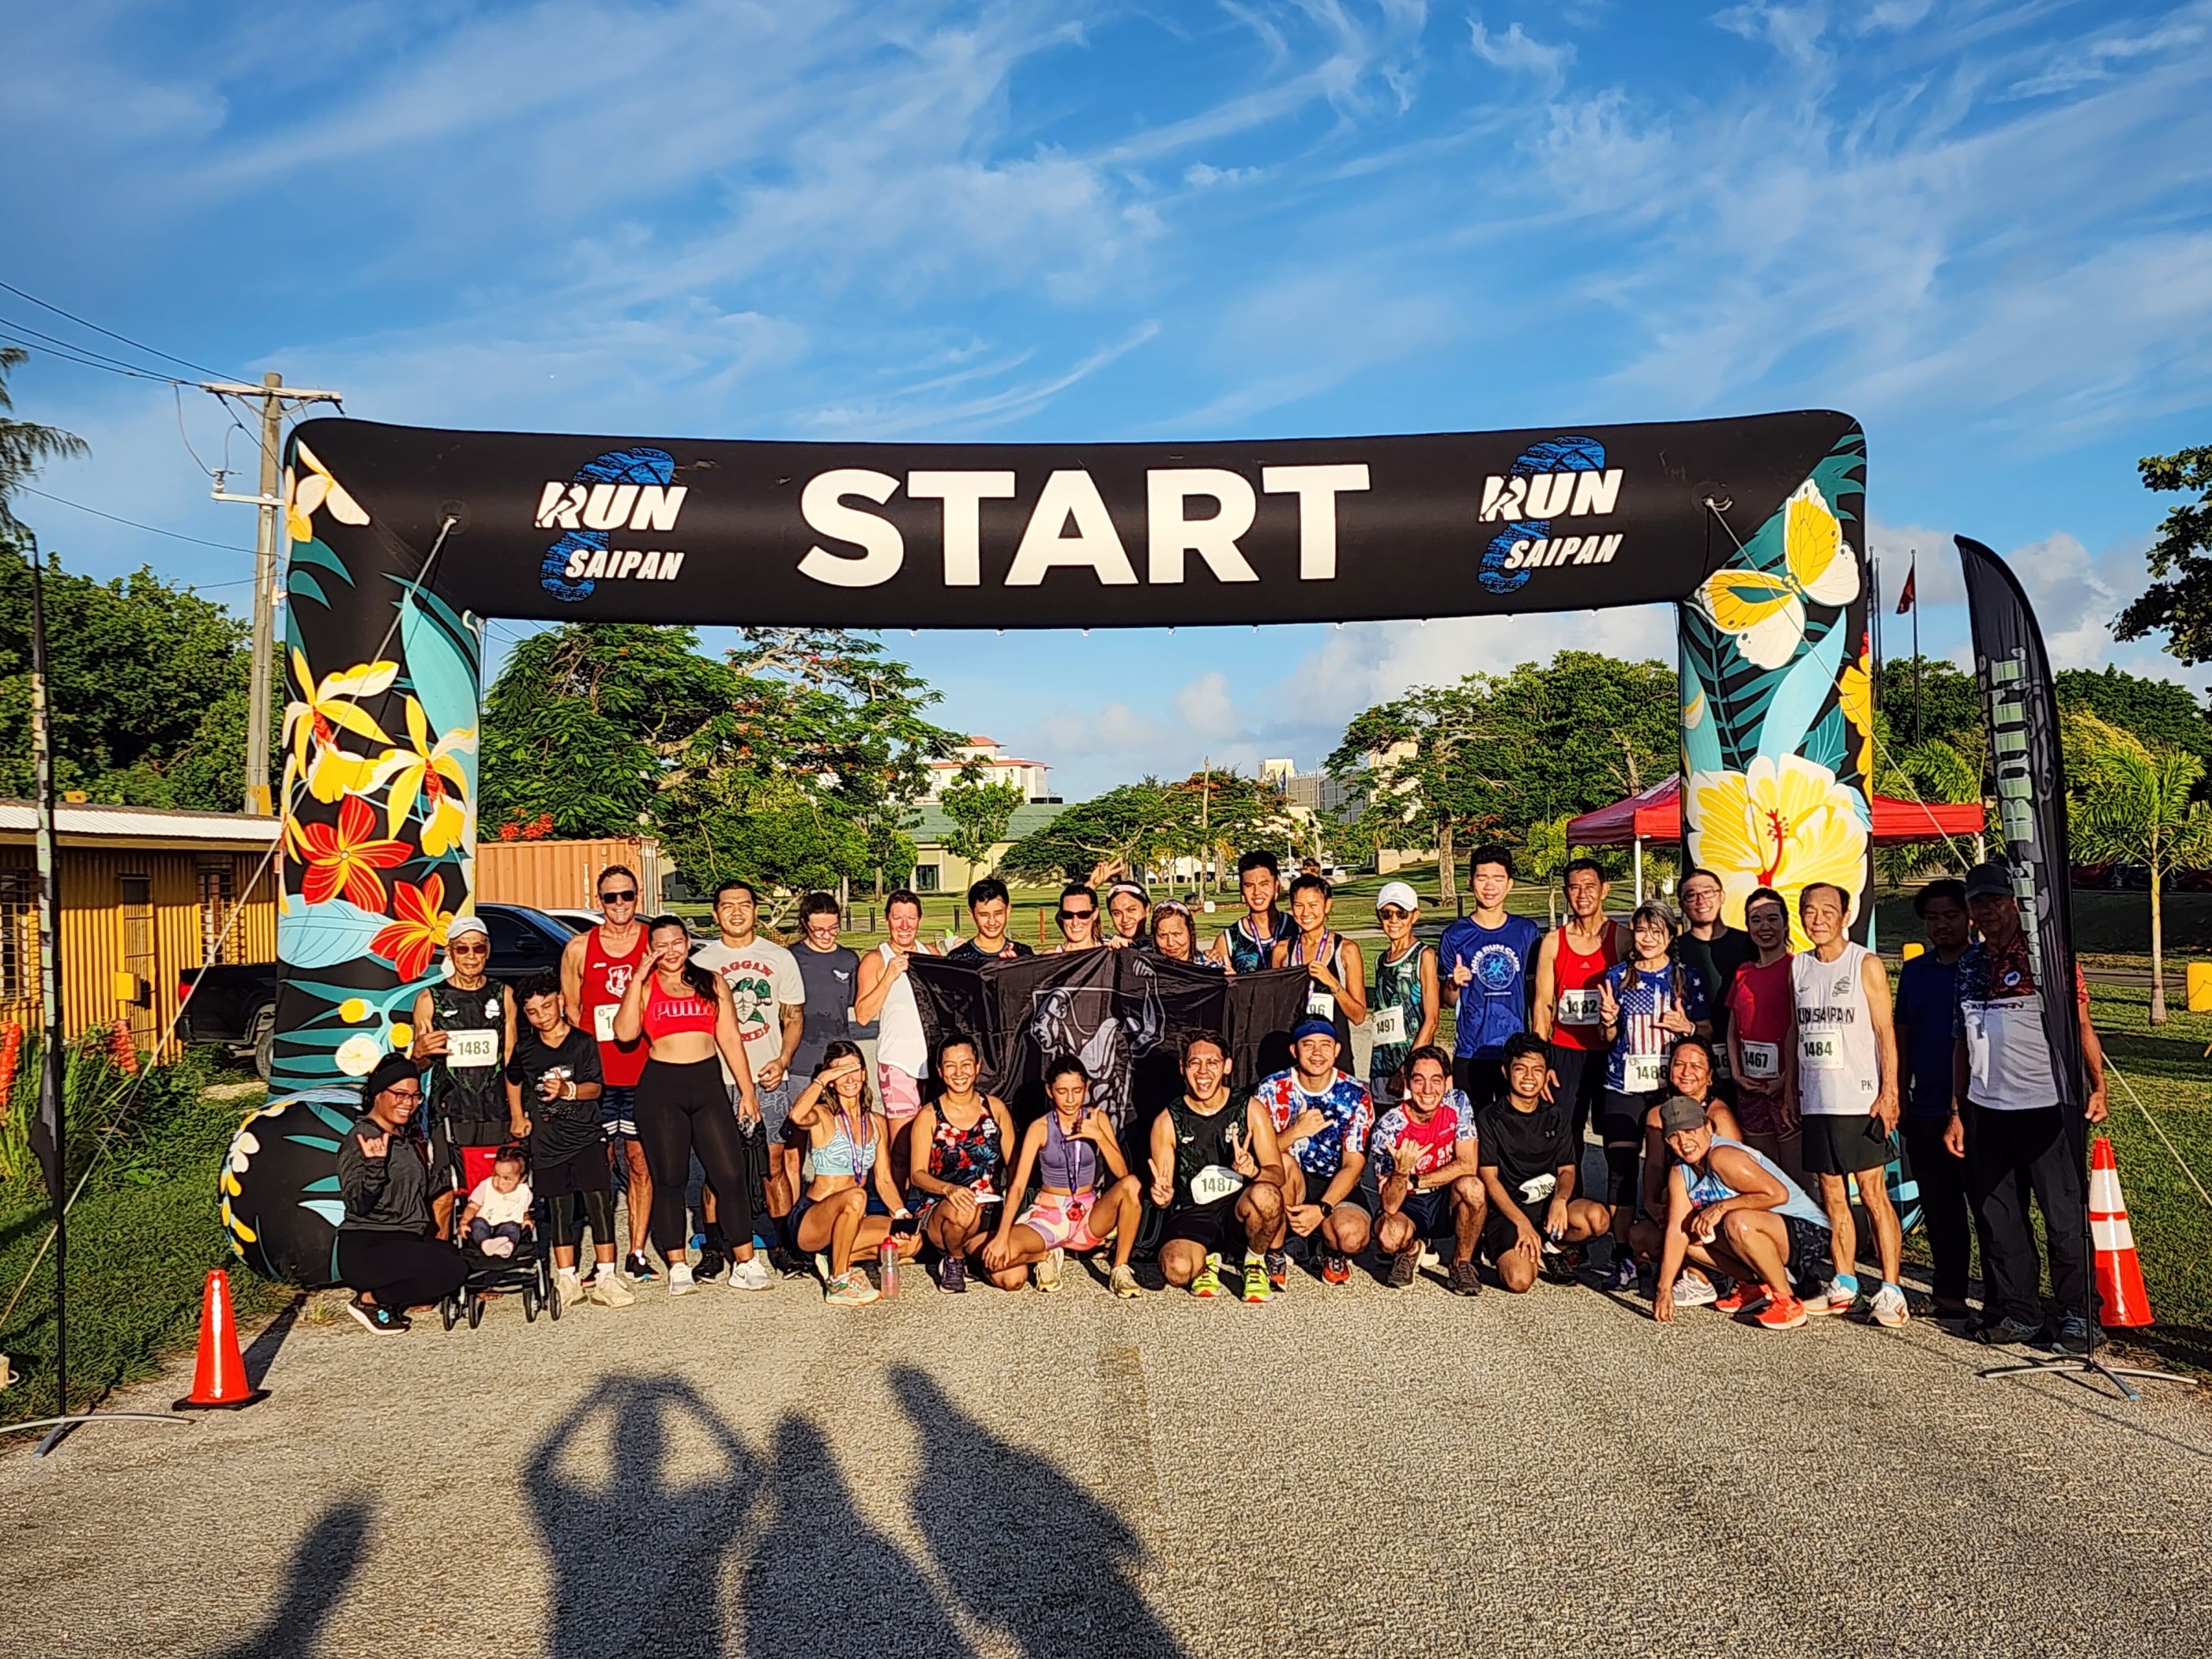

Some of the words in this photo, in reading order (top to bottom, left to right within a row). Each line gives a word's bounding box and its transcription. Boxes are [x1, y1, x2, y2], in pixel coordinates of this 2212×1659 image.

[1478, 468, 1624, 522] RUN
[535, 480, 689, 532] RUN
[796, 463, 1371, 588] START
[1503, 533, 1624, 570] SAIPAN
[565, 550, 685, 581] SAIPAN
[1567, 999, 1598, 1014] 1482
[1812, 1006, 1856, 1025] SAIPAN
[1376, 1018, 1395, 1035] 1497
[457, 1040, 491, 1055] 1483
[1803, 1040, 1833, 1058] 1484
[1744, 1051, 1769, 1069] 1467
[1635, 1065, 1669, 1080] 1488
[1860, 1079, 1873, 1091] PK
